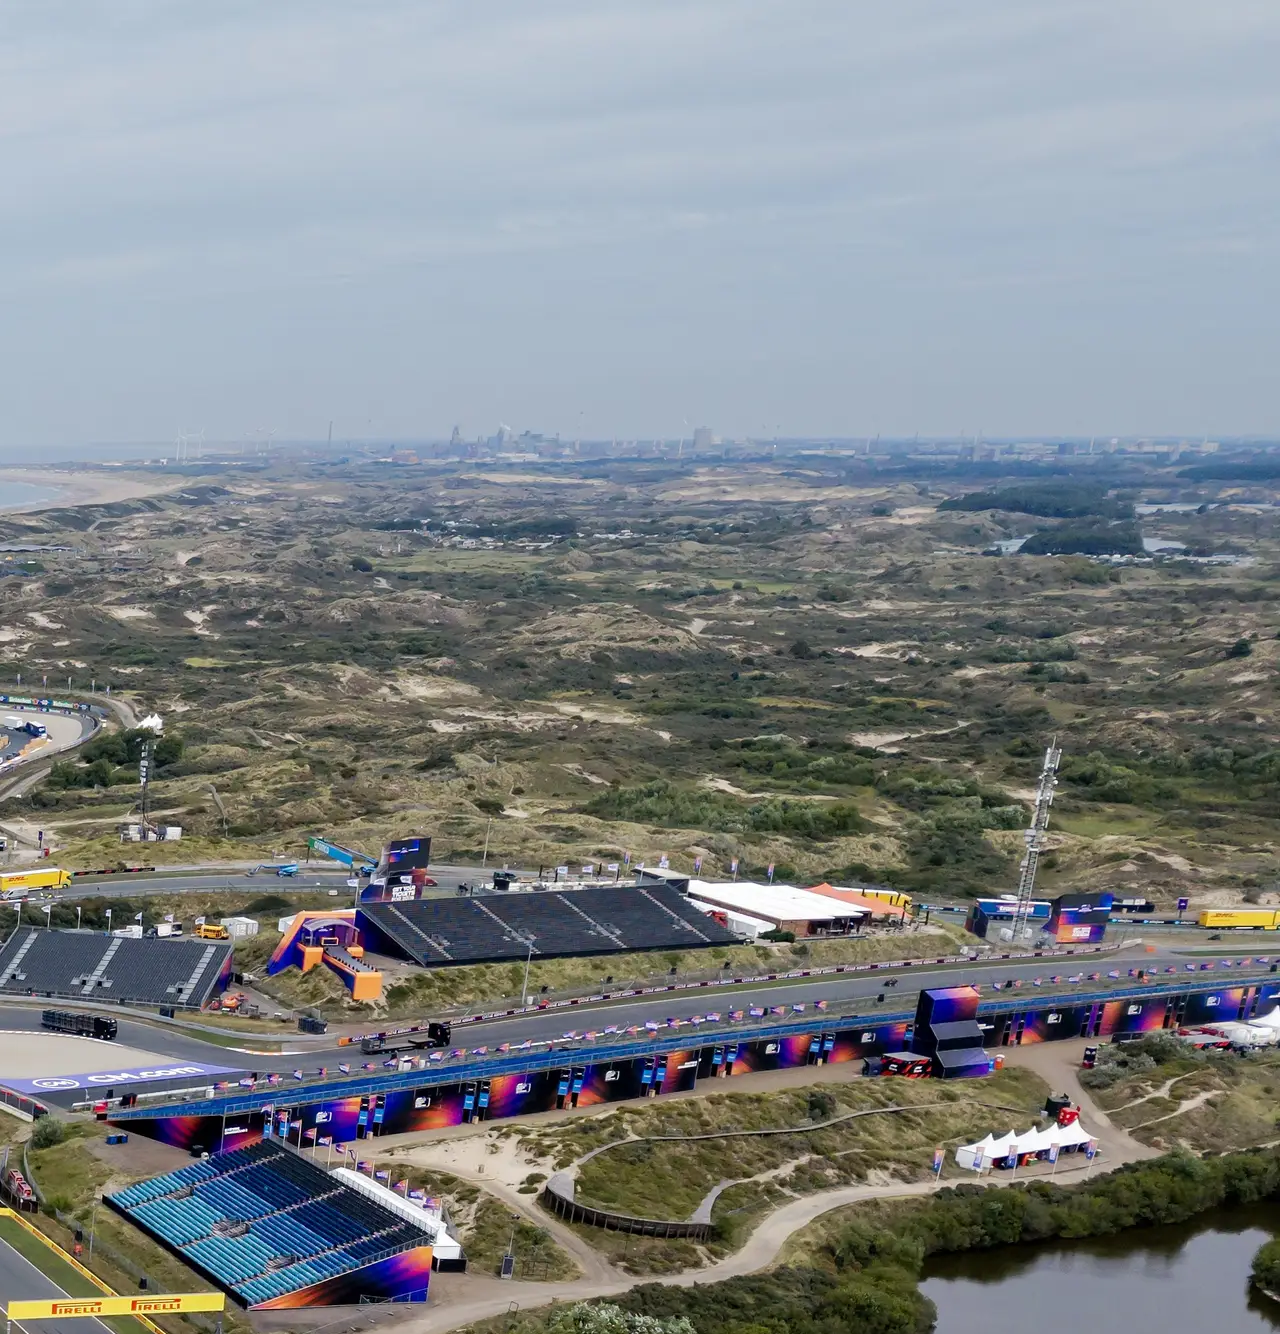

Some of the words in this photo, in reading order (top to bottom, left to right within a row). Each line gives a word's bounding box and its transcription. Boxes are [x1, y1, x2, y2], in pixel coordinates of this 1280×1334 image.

[88, 1065, 204, 1083] CM.com
[52, 1302, 102, 1315] PIRELLI
[131, 1298, 181, 1312] PIRELLI
